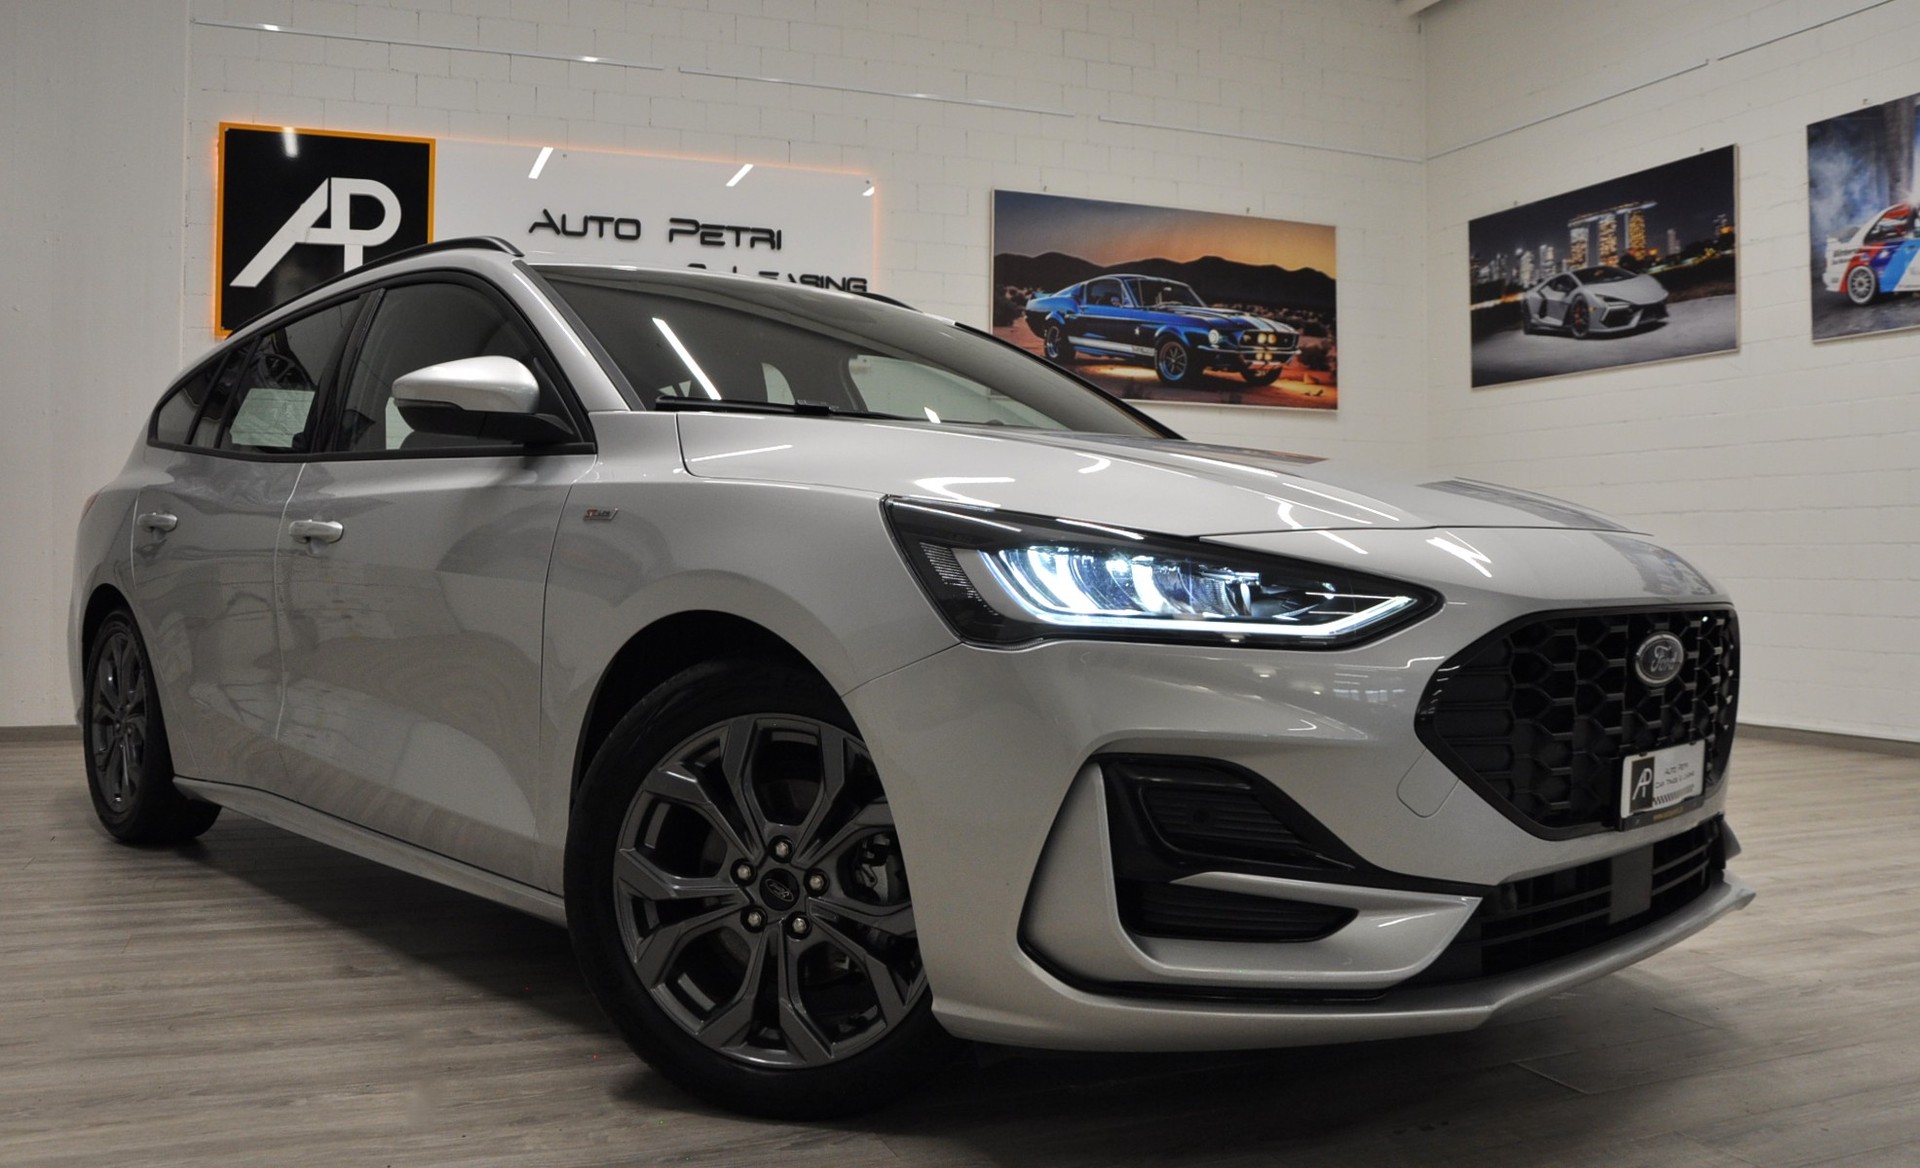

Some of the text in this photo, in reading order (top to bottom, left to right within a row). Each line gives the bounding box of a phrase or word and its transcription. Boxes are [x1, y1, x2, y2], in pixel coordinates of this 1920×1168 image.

[229, 177, 402, 287] AP
[528, 208, 782, 250] AUTO PETRI
[1650, 645, 1678, 672] Ford
[1632, 768, 1653, 800] AP
